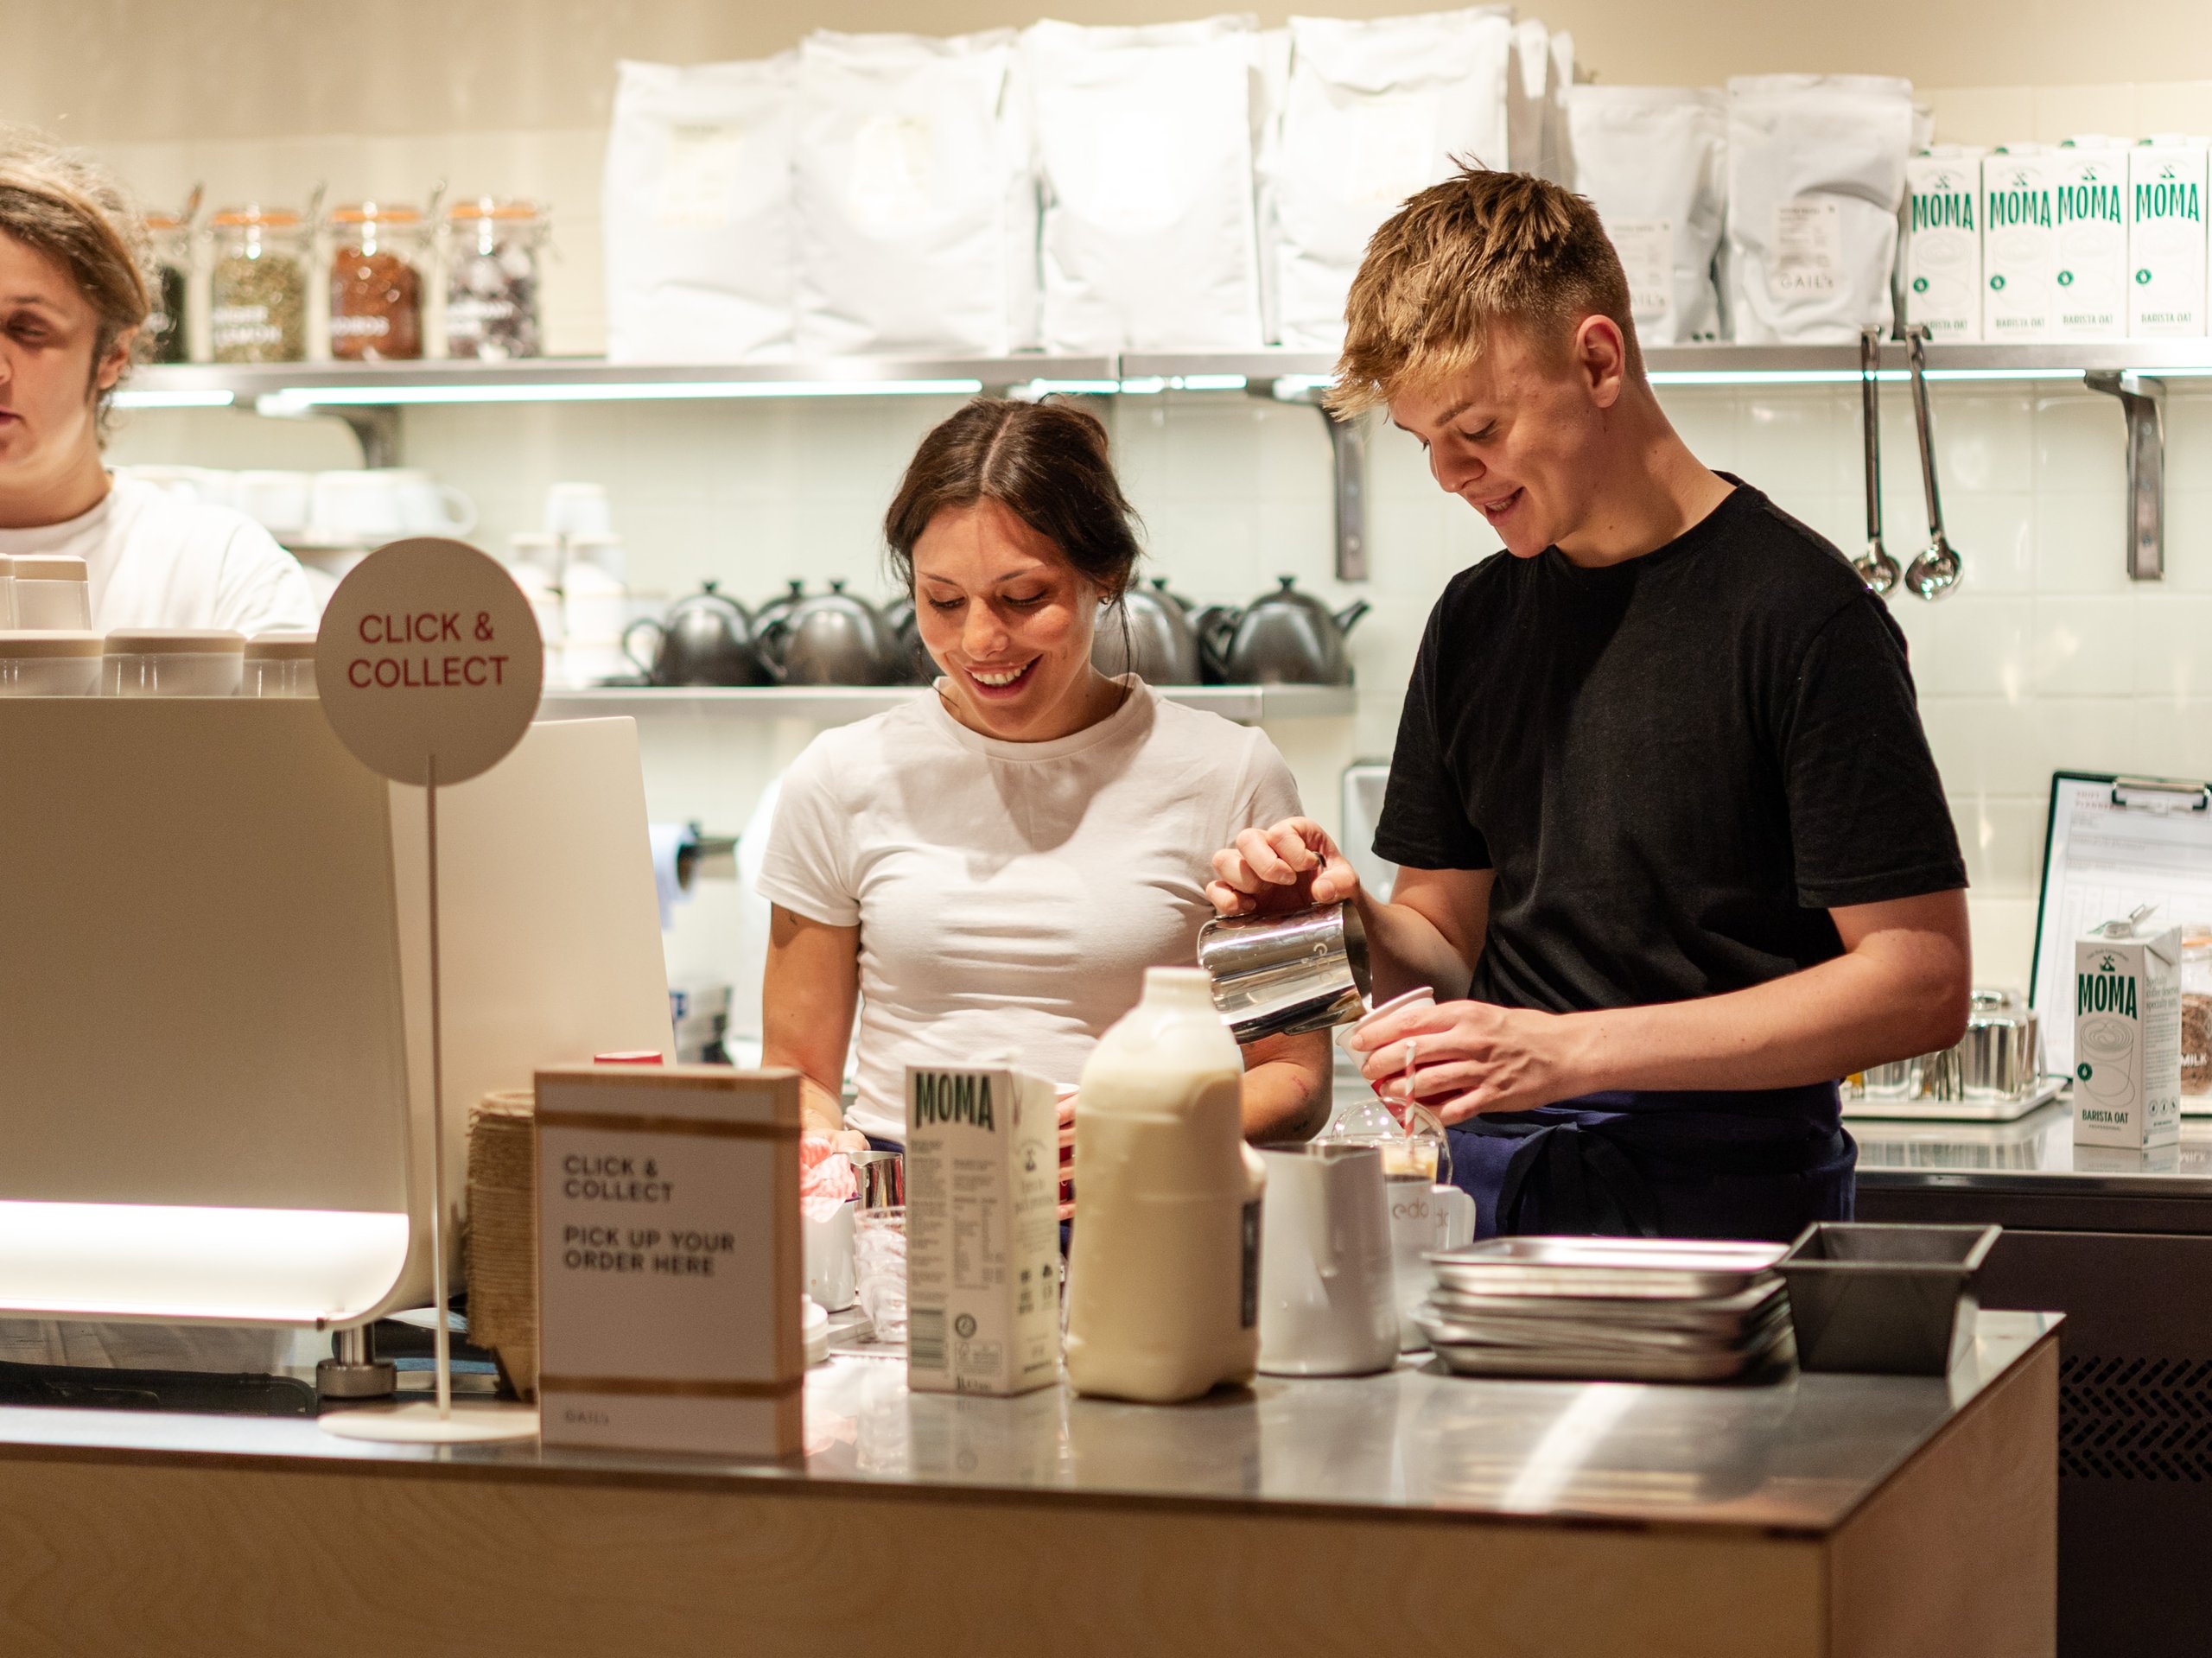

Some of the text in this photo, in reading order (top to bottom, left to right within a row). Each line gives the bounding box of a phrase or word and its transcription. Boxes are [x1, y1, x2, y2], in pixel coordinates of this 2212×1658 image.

[1912, 193, 1974, 232] MOMA
[1990, 190, 2051, 232] MOMA
[2057, 185, 2121, 226] MOMA
[2135, 183, 2200, 225] MOMA
[1954, 319, 1968, 329] OAT
[1996, 318, 2045, 328] BARISTA OAT
[2063, 314, 2113, 326] BARISTA OAT
[2141, 313, 2192, 324] BARISTA OAT
[359, 611, 495, 644] CLICK &
[347, 655, 509, 689] COLLECT
[2078, 973, 2138, 1021] MOMA
[2180, 1052, 2208, 1068] MILK
[916, 1071, 995, 1133] MOMA
[2082, 1109, 2129, 1124] BARISTA OAT
[564, 1154, 658, 1178] CLICK &
[564, 1178, 674, 1203] COLLECT
[564, 1225, 735, 1253] PICK UP YOUR
[564, 1249, 715, 1278] ORDER HERE
